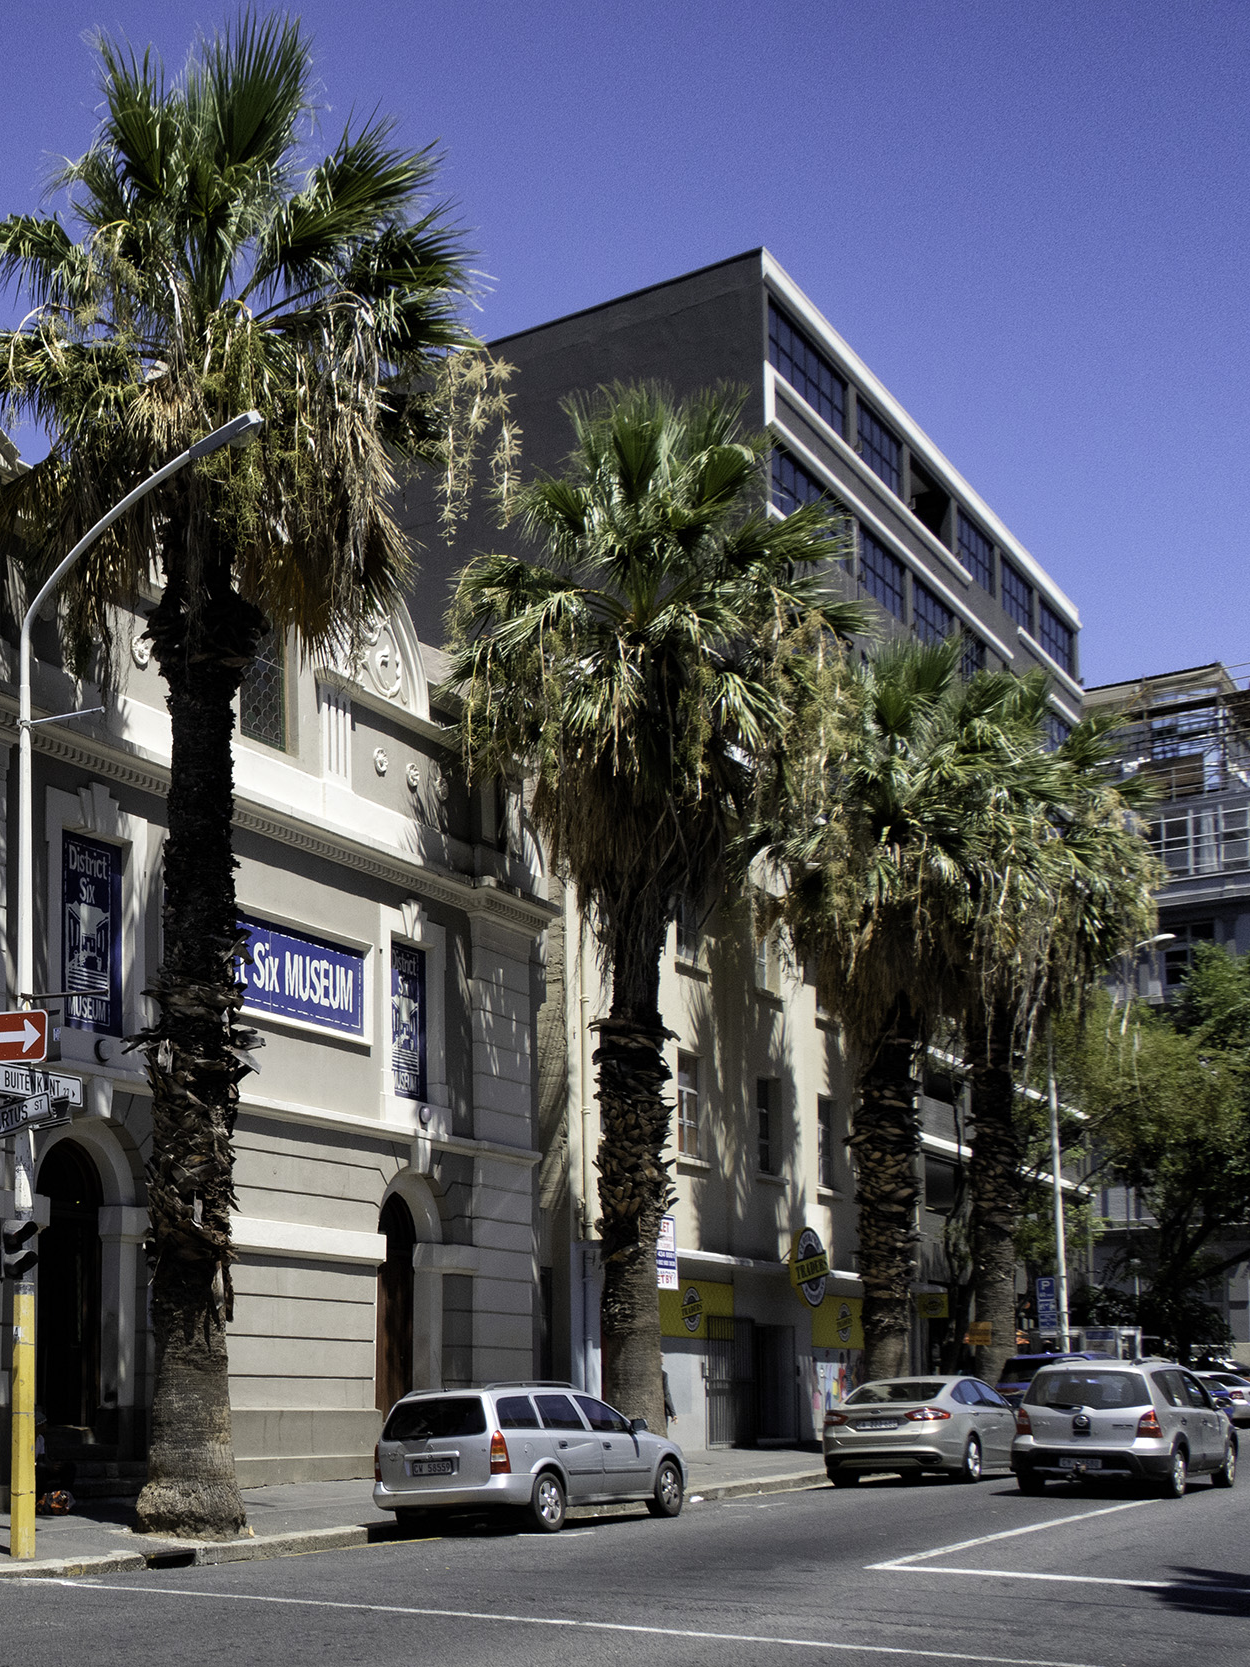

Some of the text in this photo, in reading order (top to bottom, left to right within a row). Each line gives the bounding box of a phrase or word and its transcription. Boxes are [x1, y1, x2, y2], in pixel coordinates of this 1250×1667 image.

[68, 845, 107, 881] District
[79, 876, 95, 904] Six
[391, 949, 417, 977] District
[252, 941, 280, 993] Six
[284, 951, 353, 1013] MUSEUM
[68, 993, 106, 1022] MUSEUM
[4, 1070, 60, 1097] BUITENKANT
[34, 1099, 43, 1111] ST
[796, 1258, 828, 1280] TRADERS
[1041, 1280, 1050, 1290] P
[682, 1303, 703, 1317] TRADERS
[414, 1463, 450, 1473] CW 58559
